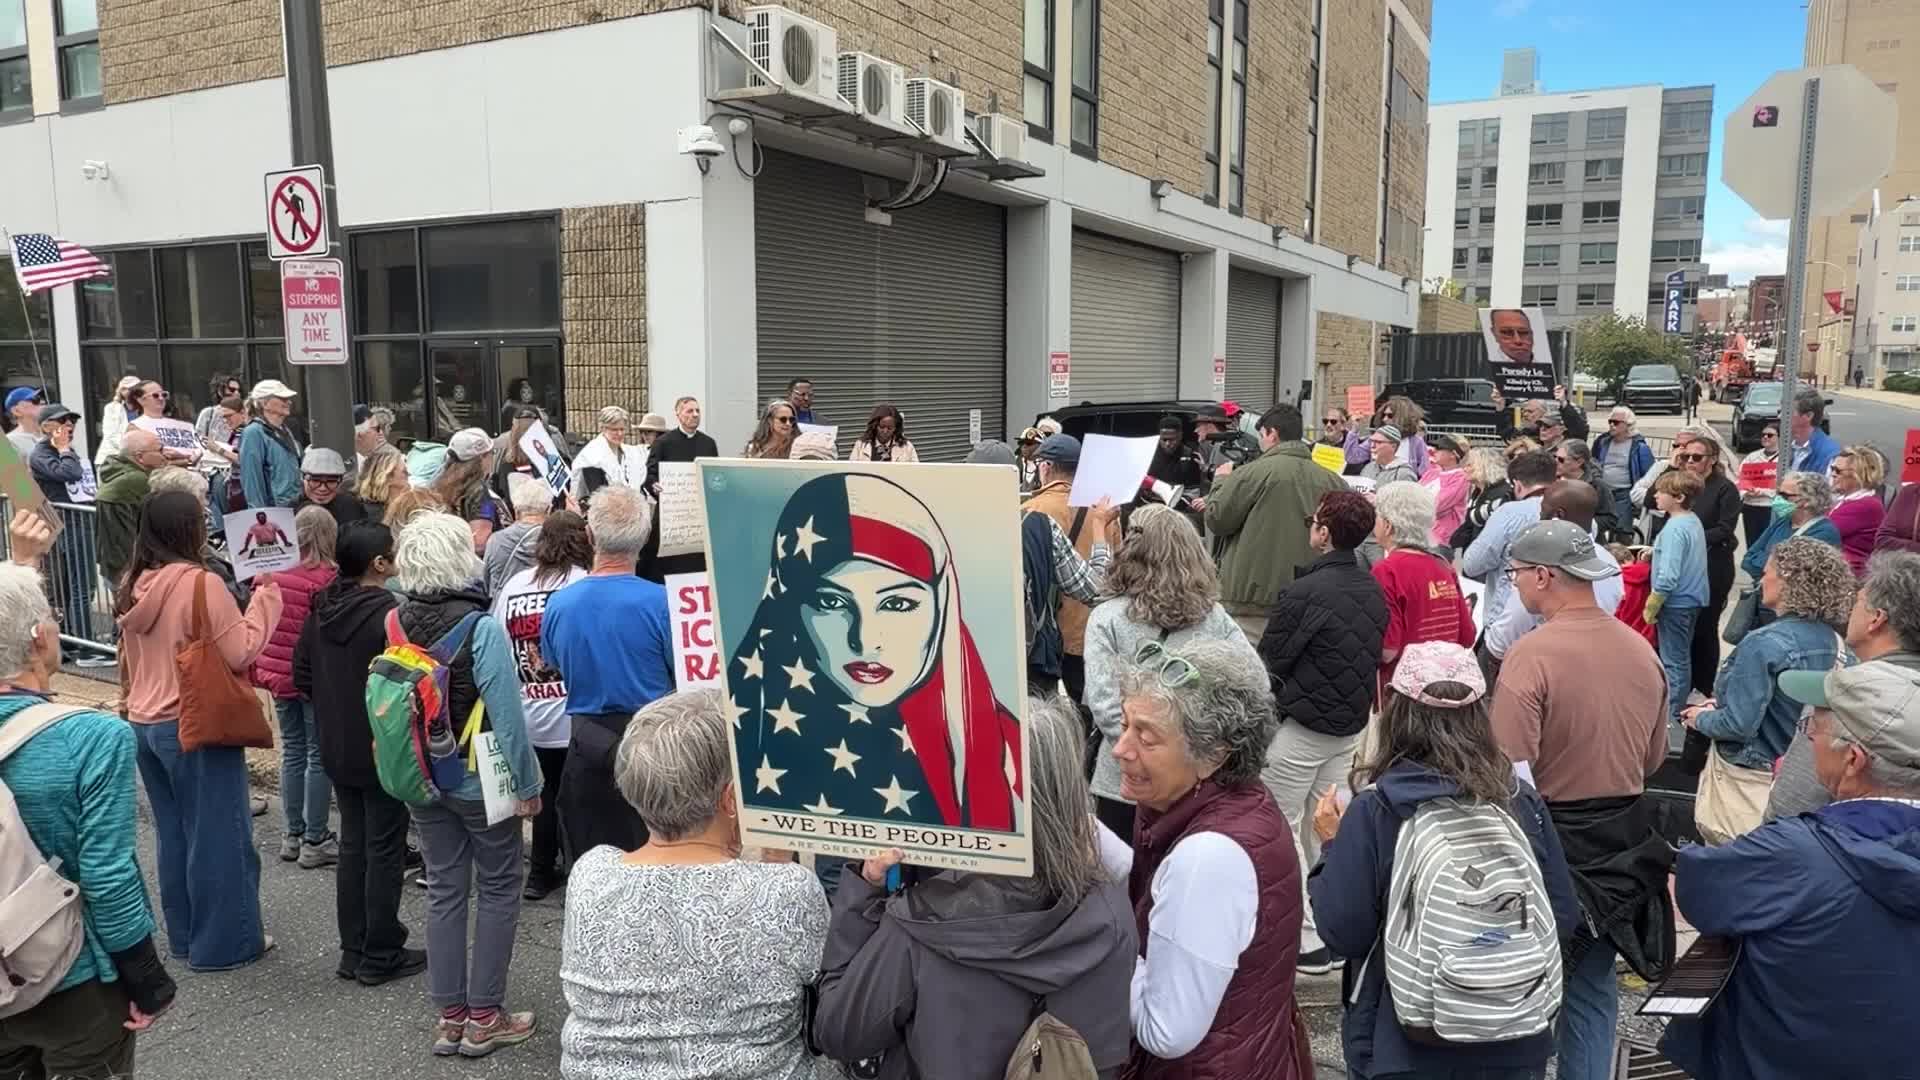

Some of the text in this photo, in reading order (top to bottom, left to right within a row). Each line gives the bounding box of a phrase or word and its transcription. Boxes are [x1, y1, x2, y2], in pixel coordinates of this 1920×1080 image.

[305, 279, 320, 291] NO
[288, 293, 338, 305] STOPPING
[303, 312, 328, 326] ANY
[1667, 290, 1680, 332] PARK
[303, 328, 331, 342] TIME
[507, 594, 546, 621] FREE
[772, 814, 992, 851] WE THE PEOPLE
[787, 840, 813, 849] ARE
[941, 859, 979, 867] FEAR
